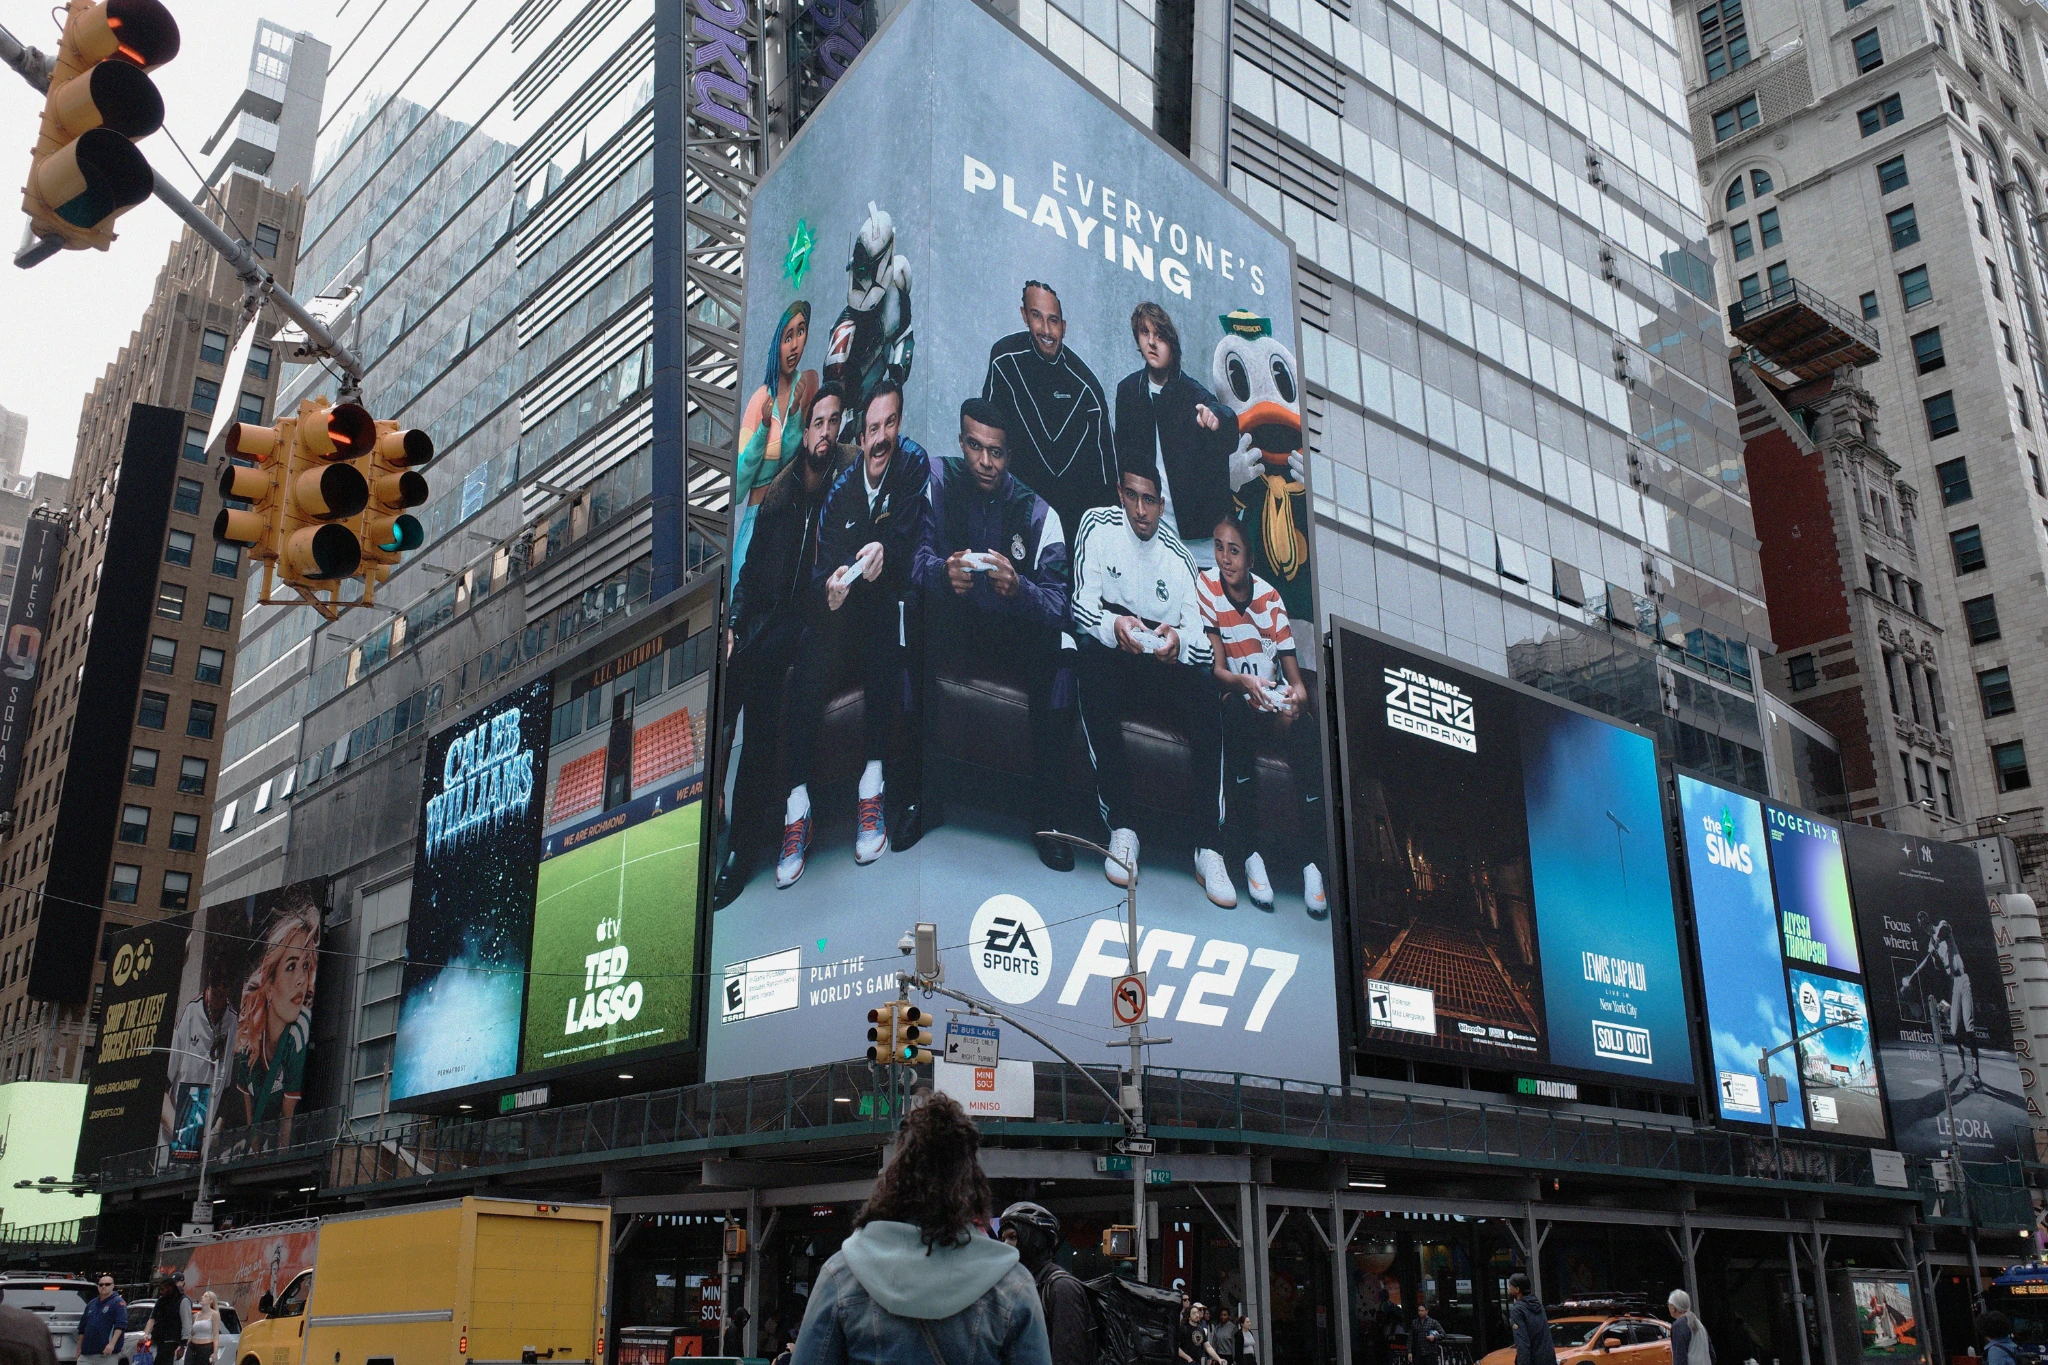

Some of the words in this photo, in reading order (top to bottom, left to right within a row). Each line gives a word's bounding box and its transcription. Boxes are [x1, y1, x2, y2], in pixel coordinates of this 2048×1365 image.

[963, 154, 1192, 300] PLAYING
[1052, 160, 1265, 296] EVERYONE'S
[26, 529, 49, 618] TIMES
[1386, 667, 1429, 687] STAR
[1384, 675, 1475, 732] ZERO
[1392, 713, 1471, 746] COMPANY
[443, 707, 521, 789] CALEB
[426, 749, 534, 845] WILLIAMS
[676, 786, 689, 801] WE
[563, 833, 575, 847] WE
[574, 827, 588, 843] ARE
[588, 812, 627, 838] RICHMOND
[1702, 815, 1722, 835] the
[1705, 833, 1753, 875] SIMS
[1783, 910, 1811, 939] ALYSSA
[1883, 915, 1911, 933] Focus
[984, 916, 1038, 958] EA
[1883, 934, 1911, 949] where
[1911, 937, 1919, 951] it
[1785, 934, 1828, 966] THOMPSON
[115, 953, 131, 976] JD
[585, 945, 629, 991] TED
[810, 961, 838, 982] PLAY
[842, 955, 865, 975] THE
[983, 953, 1040, 976] SPORTS
[1582, 951, 1611, 985] LEWIS
[1611, 957, 1647, 991] CAPALDI
[726, 979, 743, 1011] E
[810, 980, 863, 1007] WORLD'S
[103, 1002, 126, 1034] SHOP
[123, 999, 141, 1030] THE
[136, 992, 168, 1027] LATEST
[564, 981, 643, 1035] LASSO
[722, 1013, 744, 1023] ESRB
[1372, 995, 1388, 1018] T
[1599, 998, 1612, 1011] New
[1612, 1000, 1626, 1014] York
[1626, 1003, 1638, 1019] City
[1989, 898, 2047, 1128] AMSTERDA
[961, 1027, 975, 1035] BUS
[977, 1028, 996, 1037] LANE
[963, 1037, 979, 1045] BUSES
[981, 1038, 994, 1046] ONLY
[1597, 1027, 1624, 1051] SOLD
[1626, 1032, 1646, 1055] OUT
[1900, 1029, 1934, 1044] matters
[98, 1030, 130, 1064] SOCCER
[126, 1024, 158, 1059] STYLES
[1908, 1049, 1934, 1062] most.
[961, 1053, 975, 1061] RIGHT
[978, 1055, 994, 1063] TURNS
[437, 1064, 467, 1077] PERMAFROST
[976, 1071, 993, 1079] MINI
[105, 1078, 141, 1094] BROADWAY
[1722, 1080, 1732, 1097] T
[89, 1106, 125, 1120] JDSPORTS.COM
[969, 1101, 1000, 1111] MINISO
[1936, 1116, 1993, 1139] LEGORA
[1138, 1143, 1151, 1151] WAY
[1112, 1158, 1118, 1169] 7
[1158, 1171, 1165, 1182] 42
[702, 1285, 721, 1301] MIN
